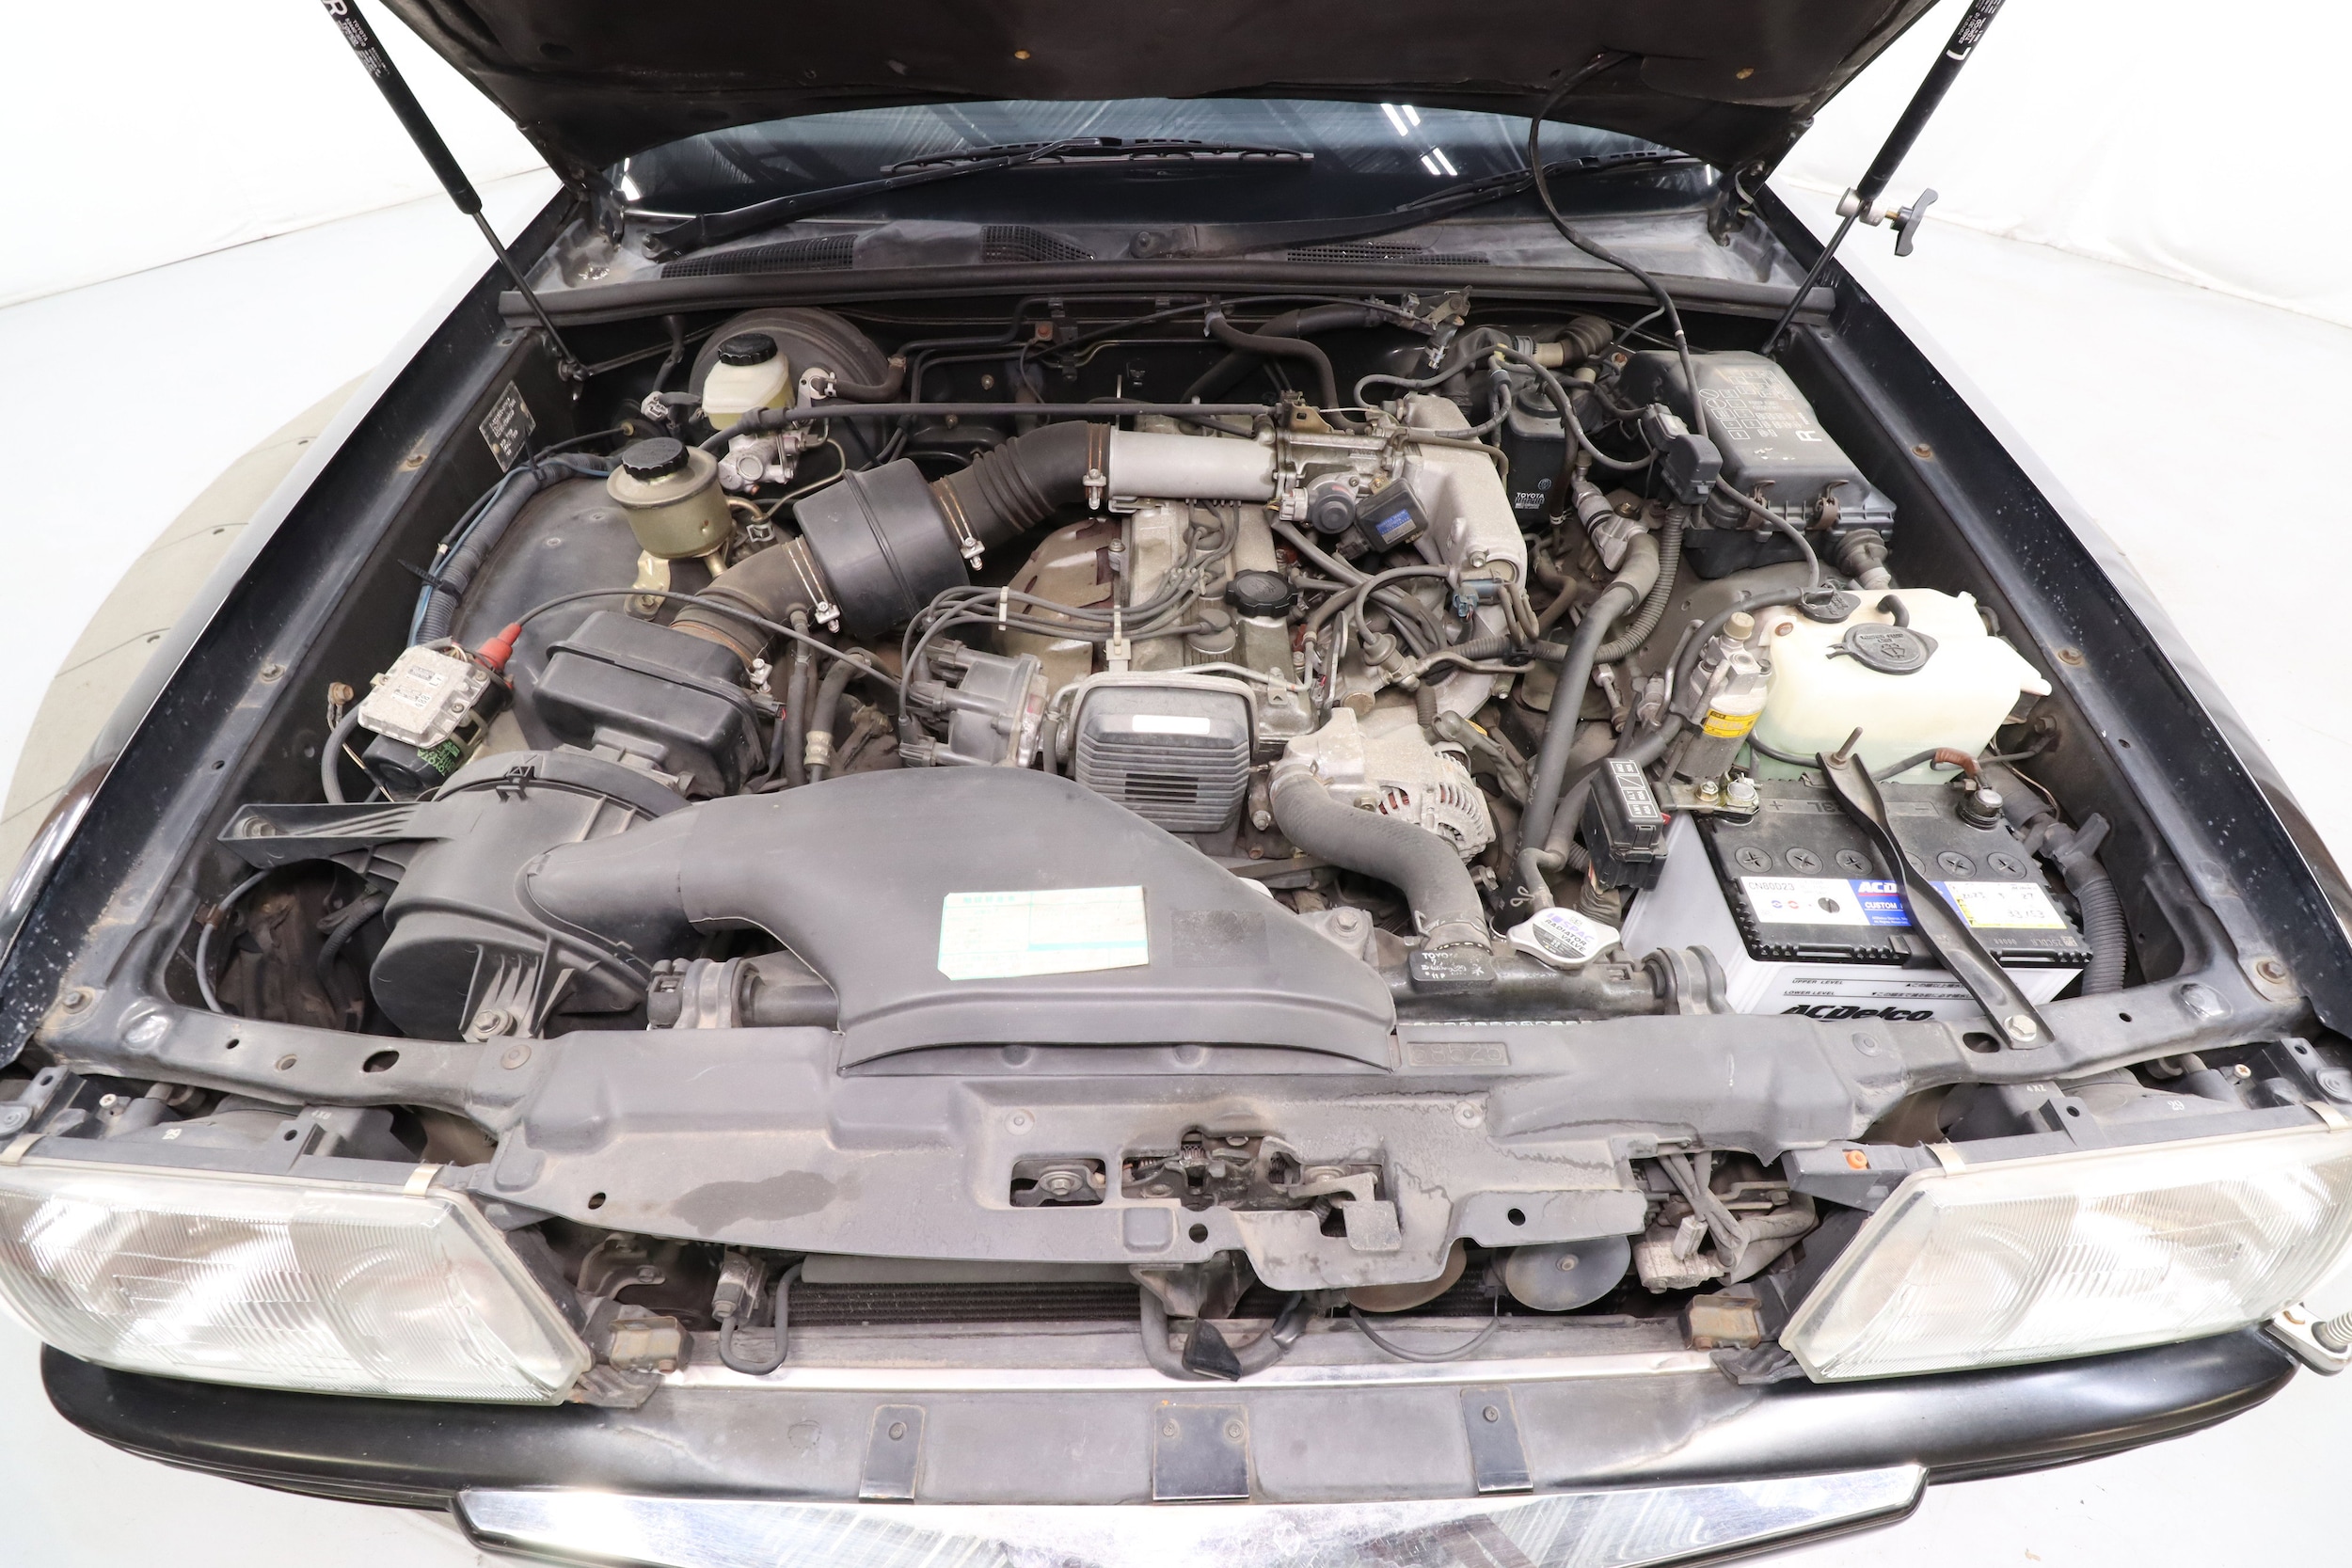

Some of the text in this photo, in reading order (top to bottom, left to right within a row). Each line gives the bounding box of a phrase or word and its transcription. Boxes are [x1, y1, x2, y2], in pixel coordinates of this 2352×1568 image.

[353, 20, 369, 42] TOYOTA
[1958, 15, 1973, 36] TOYOTA
[1946, 47, 1972, 61] L
[417, 748, 446, 777] TOYOTA
[1627, 790, 1637, 800] ALT
[1865, 901, 1898, 910] CUSTOM
[1544, 919, 1587, 946] RADIATOR
[1561, 934, 1587, 952] VALVE
[1780, 1005, 1934, 1022] ACDelco
[2167, 1100, 2185, 1111] 29
[161, 1128, 183, 1140] 29
